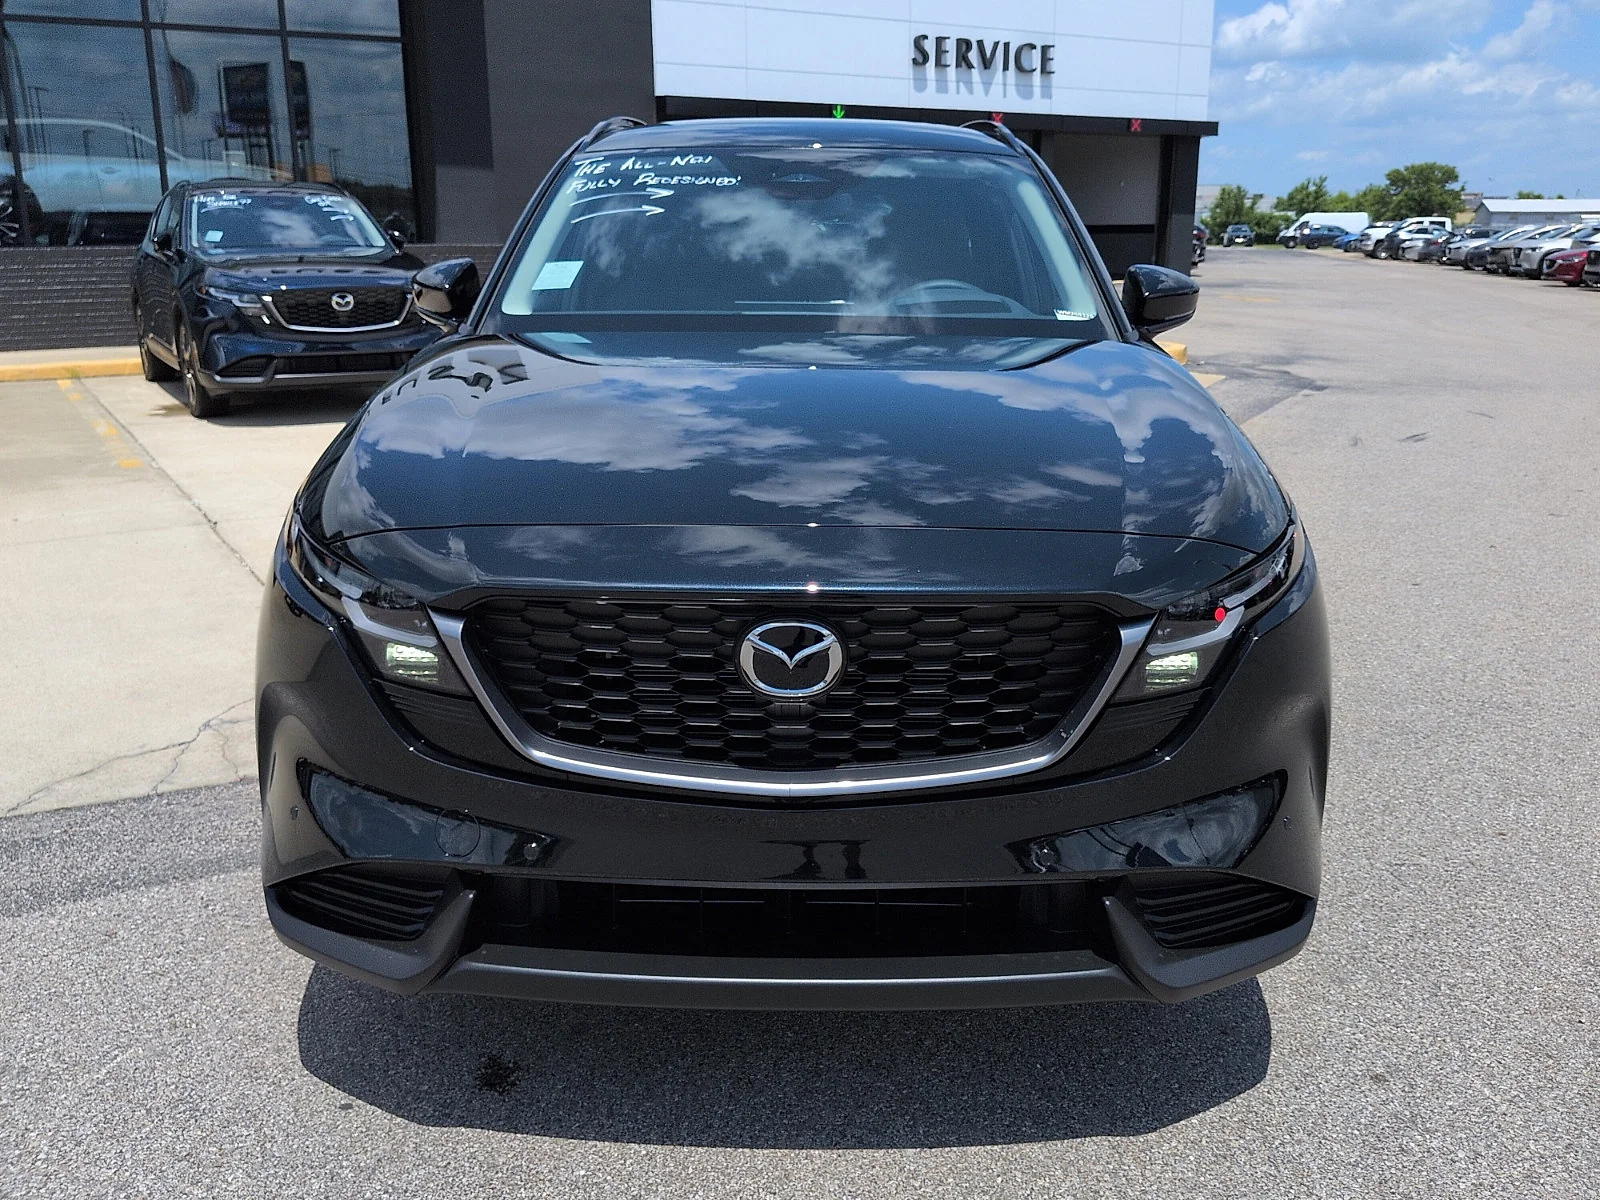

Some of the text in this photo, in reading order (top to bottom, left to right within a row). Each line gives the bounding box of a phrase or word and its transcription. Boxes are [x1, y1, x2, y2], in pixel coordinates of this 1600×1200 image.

[912, 34, 1055, 75] SERVICE
[574, 156, 612, 178] THE
[566, 178, 622, 195] FULLY
